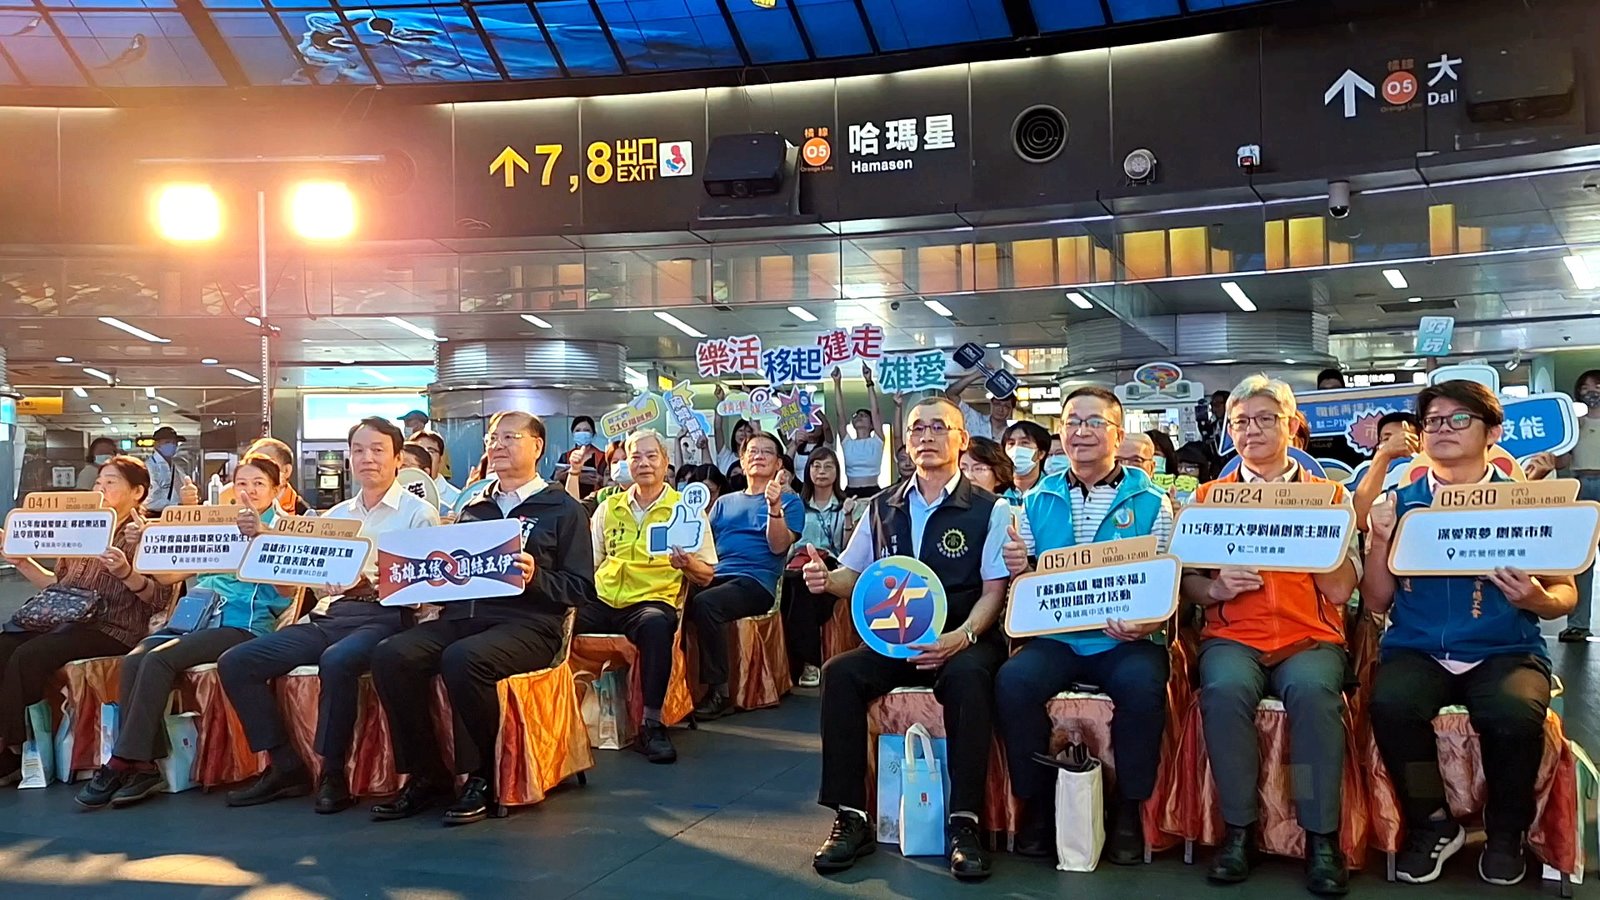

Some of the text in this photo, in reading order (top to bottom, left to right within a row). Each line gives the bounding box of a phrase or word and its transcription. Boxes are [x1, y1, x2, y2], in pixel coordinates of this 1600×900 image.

[1427, 53, 1462, 88] 大
[848, 114, 956, 155] 哈瑪星
[616, 138, 658, 166] 出口
[616, 163, 658, 183] EXIT
[851, 156, 913, 174] Hamasen
[698, 337, 760, 375] 樂活
[817, 326, 883, 366] 健走
[764, 348, 822, 384] 移起
[879, 351, 947, 391] 雄愛
[28, 497, 59, 509] 04/11
[1212, 488, 1262, 504] 05/24
[1441, 489, 1497, 507] 05/30
[165, 510, 201, 522] 04/18
[278, 519, 315, 534] 04/25
[1044, 549, 1091, 570] 05/16
